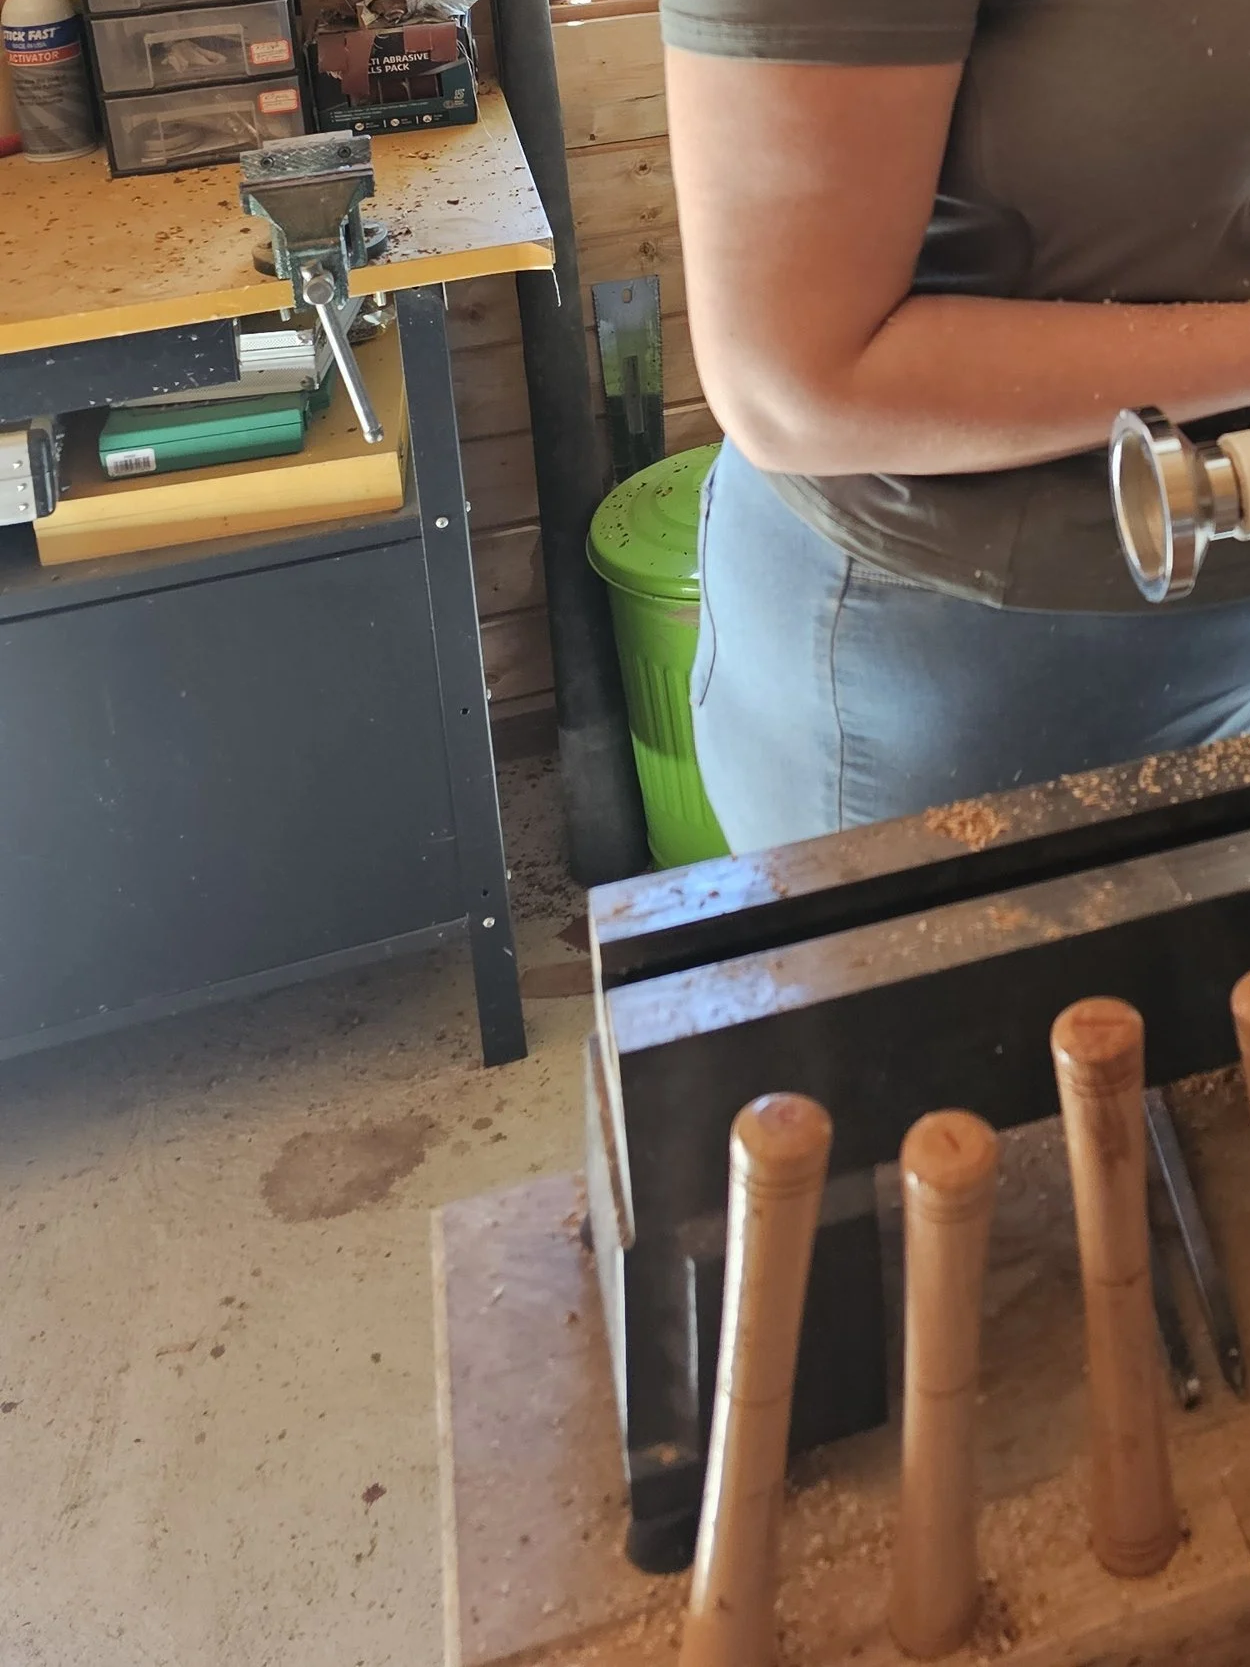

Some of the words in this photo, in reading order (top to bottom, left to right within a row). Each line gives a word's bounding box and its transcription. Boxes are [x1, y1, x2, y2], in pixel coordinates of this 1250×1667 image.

[28, 28, 56, 41] FAST
[383, 52, 429, 65] ABRASIVE
[385, 63, 410, 73] PACK
